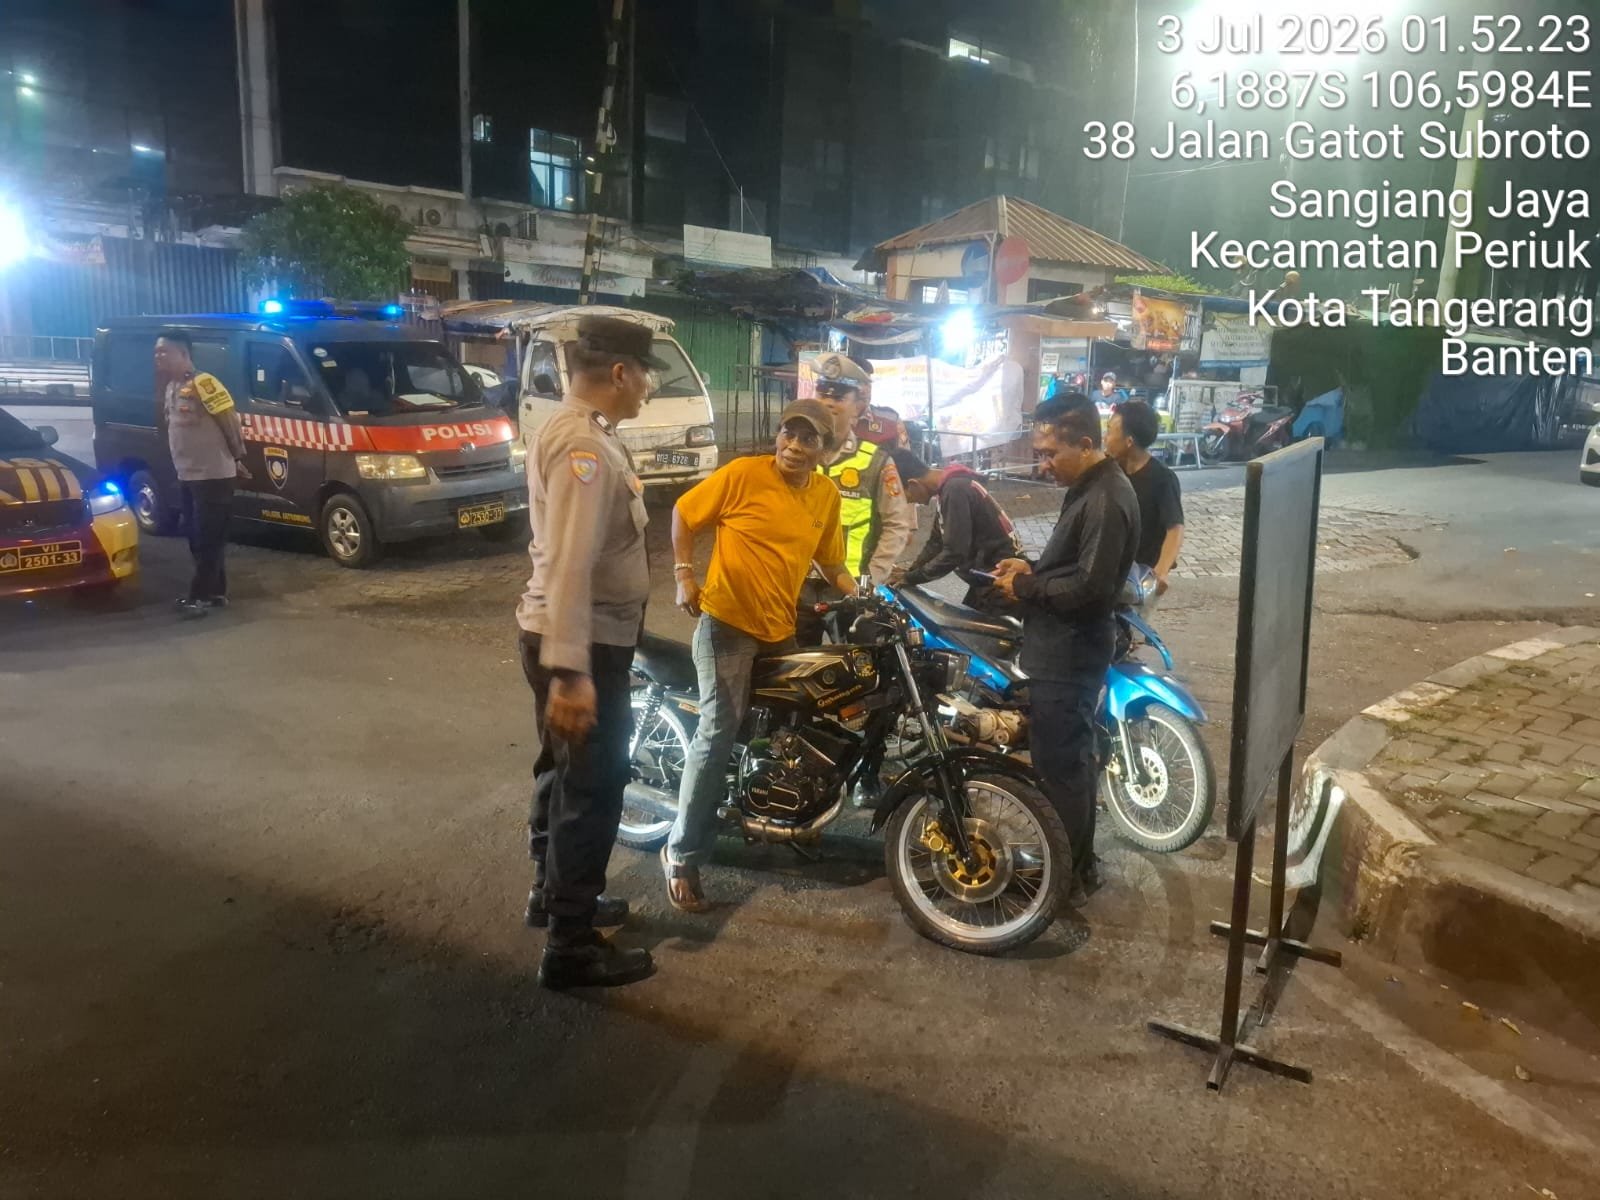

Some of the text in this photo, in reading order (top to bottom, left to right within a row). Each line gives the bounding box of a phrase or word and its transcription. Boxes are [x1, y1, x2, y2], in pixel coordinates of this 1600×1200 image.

[421, 423, 493, 441] POLISI
[42, 543, 60, 553] VII
[25, 551, 78, 568] 2501-33
